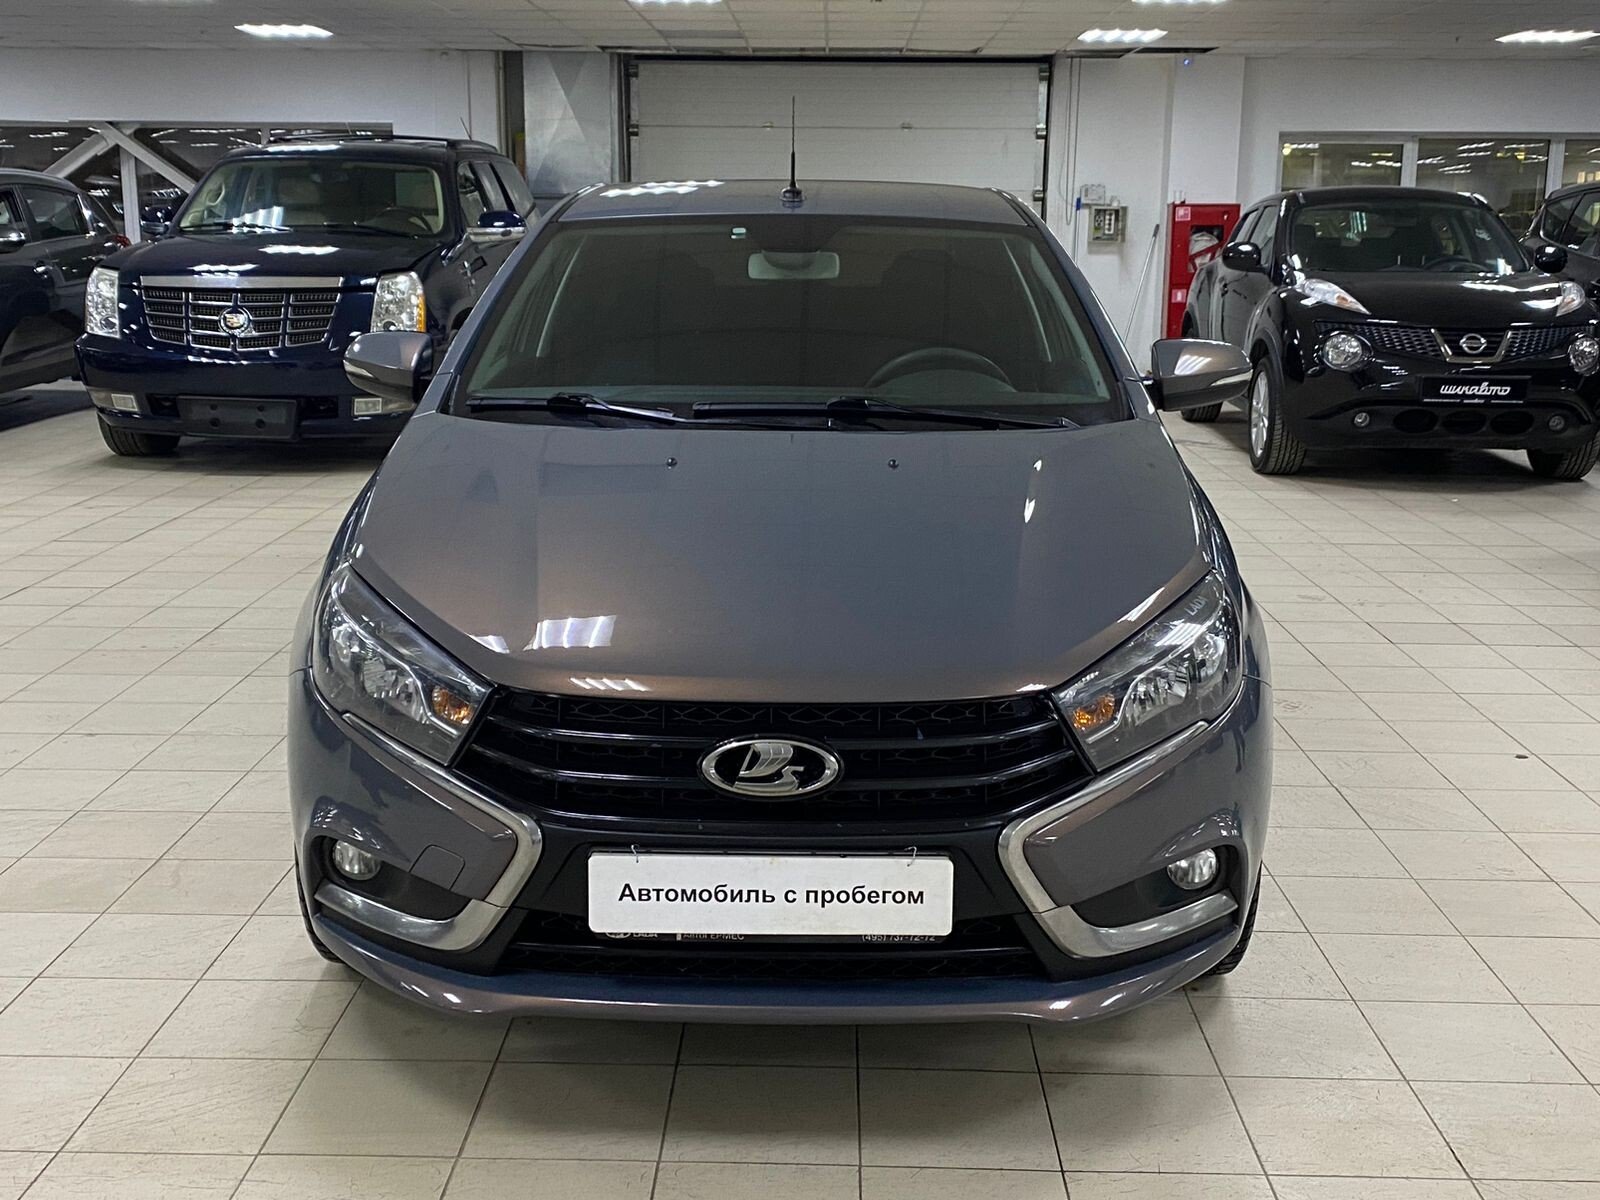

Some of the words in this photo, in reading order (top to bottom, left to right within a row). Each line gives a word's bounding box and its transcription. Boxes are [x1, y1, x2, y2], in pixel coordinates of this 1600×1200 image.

[618, 883, 775, 903] Автомобиль
[785, 889, 796, 903] с
[805, 885, 924, 909] пробегом
